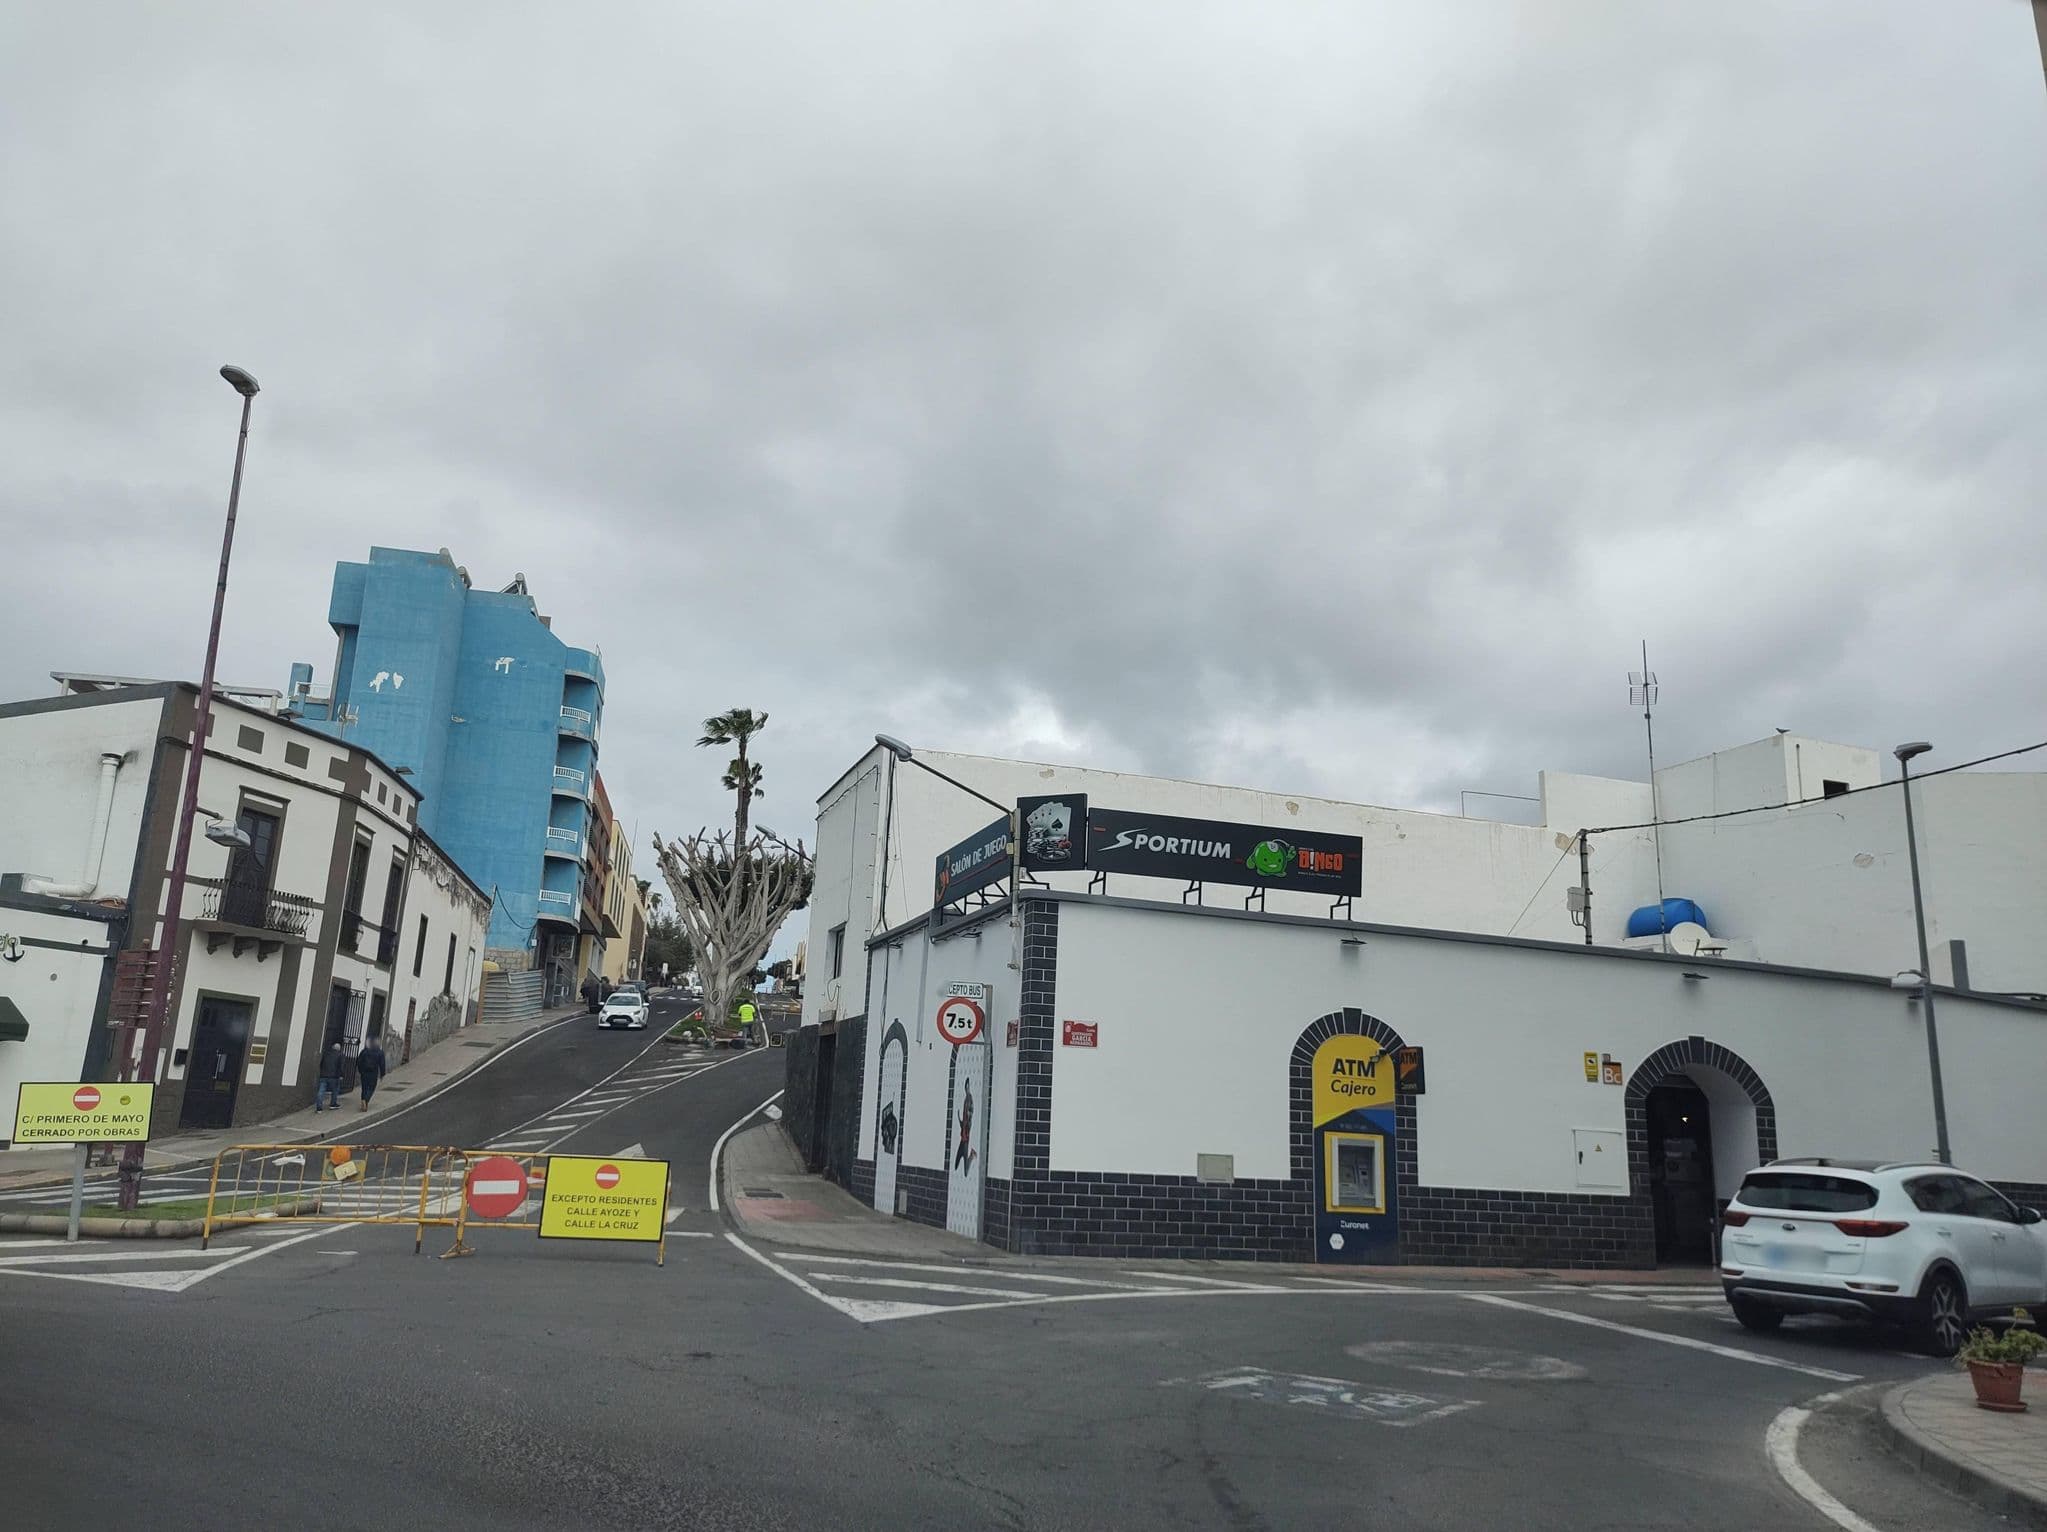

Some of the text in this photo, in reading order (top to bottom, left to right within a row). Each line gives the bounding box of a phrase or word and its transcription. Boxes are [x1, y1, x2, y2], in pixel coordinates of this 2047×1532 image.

[1097, 827, 1231, 859] SPORTIUM
[972, 848, 982, 866] DE
[983, 835, 1007, 860] JUEGO
[969, 985, 981, 996] BUS
[1332, 1058, 1376, 1078] ATM
[1330, 1080, 1376, 1096] Cajero
[22, 1114, 144, 1124] C/ PRIMERO DE MAYO
[22, 1128, 140, 1137] CERRADO POR OBRAS
[551, 1194, 657, 1206] EXCEPTO RESIDENTES
[566, 1207, 640, 1217] CALLE AYOZE Y
[564, 1219, 639, 1230] CALLE LA CRUZ
